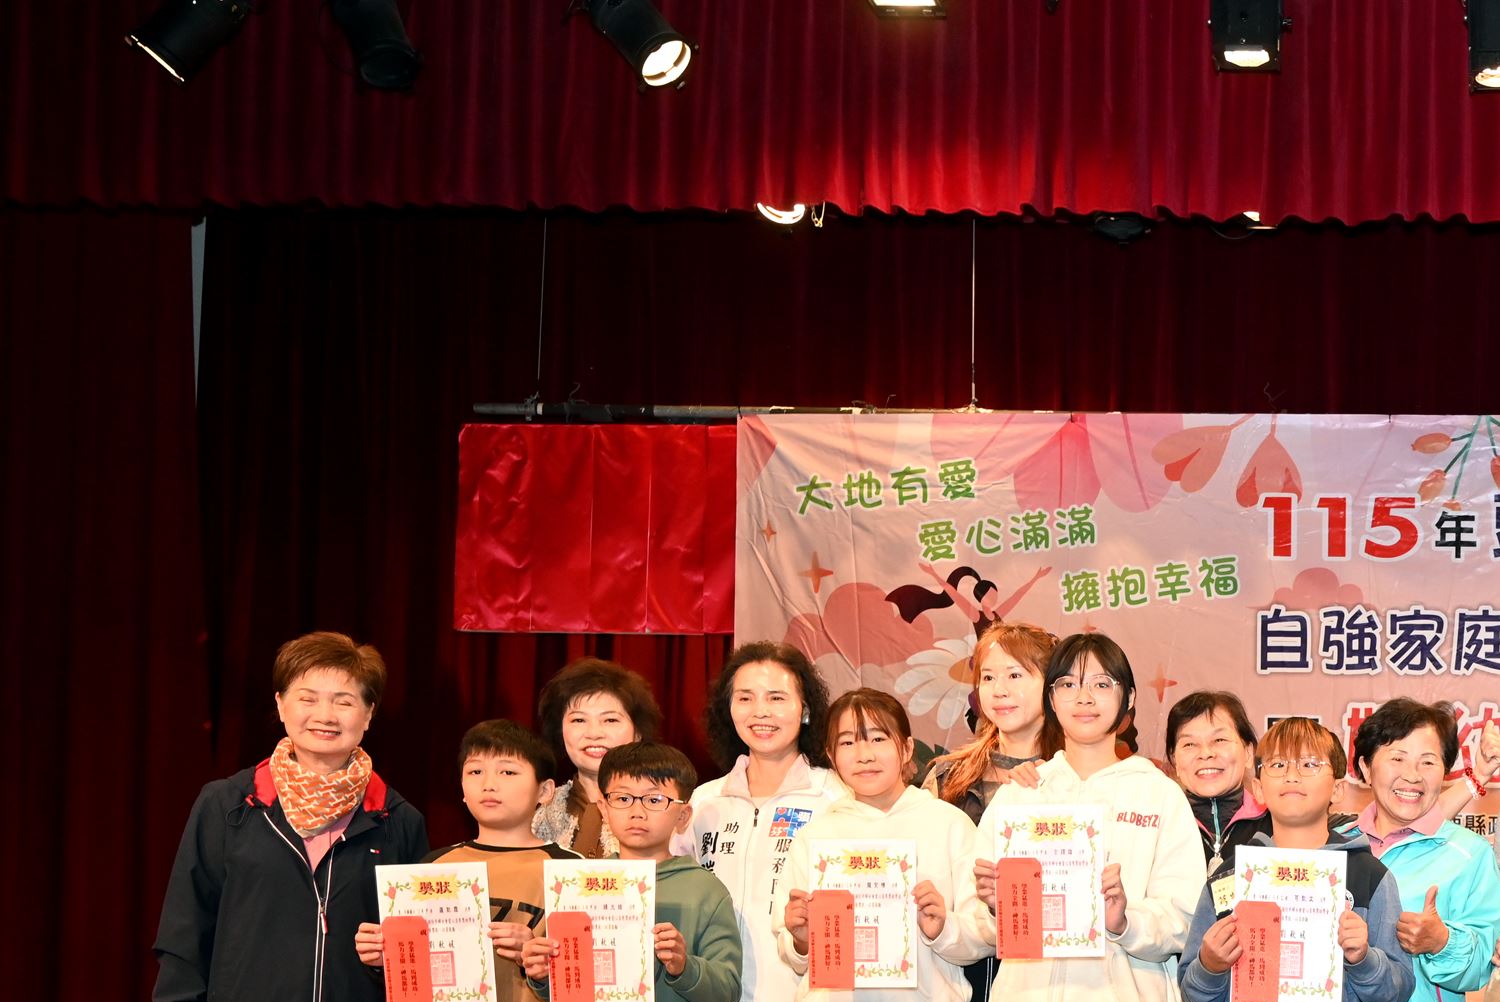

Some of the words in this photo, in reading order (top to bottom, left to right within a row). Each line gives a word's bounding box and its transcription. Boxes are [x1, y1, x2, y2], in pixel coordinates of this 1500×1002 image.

[795, 458, 977, 515] 大地有愛
[918, 505, 1097, 562] 愛心滿滿
[1061, 556, 1240, 614] 擁抱幸福
[720, 821, 740, 855] 助理
